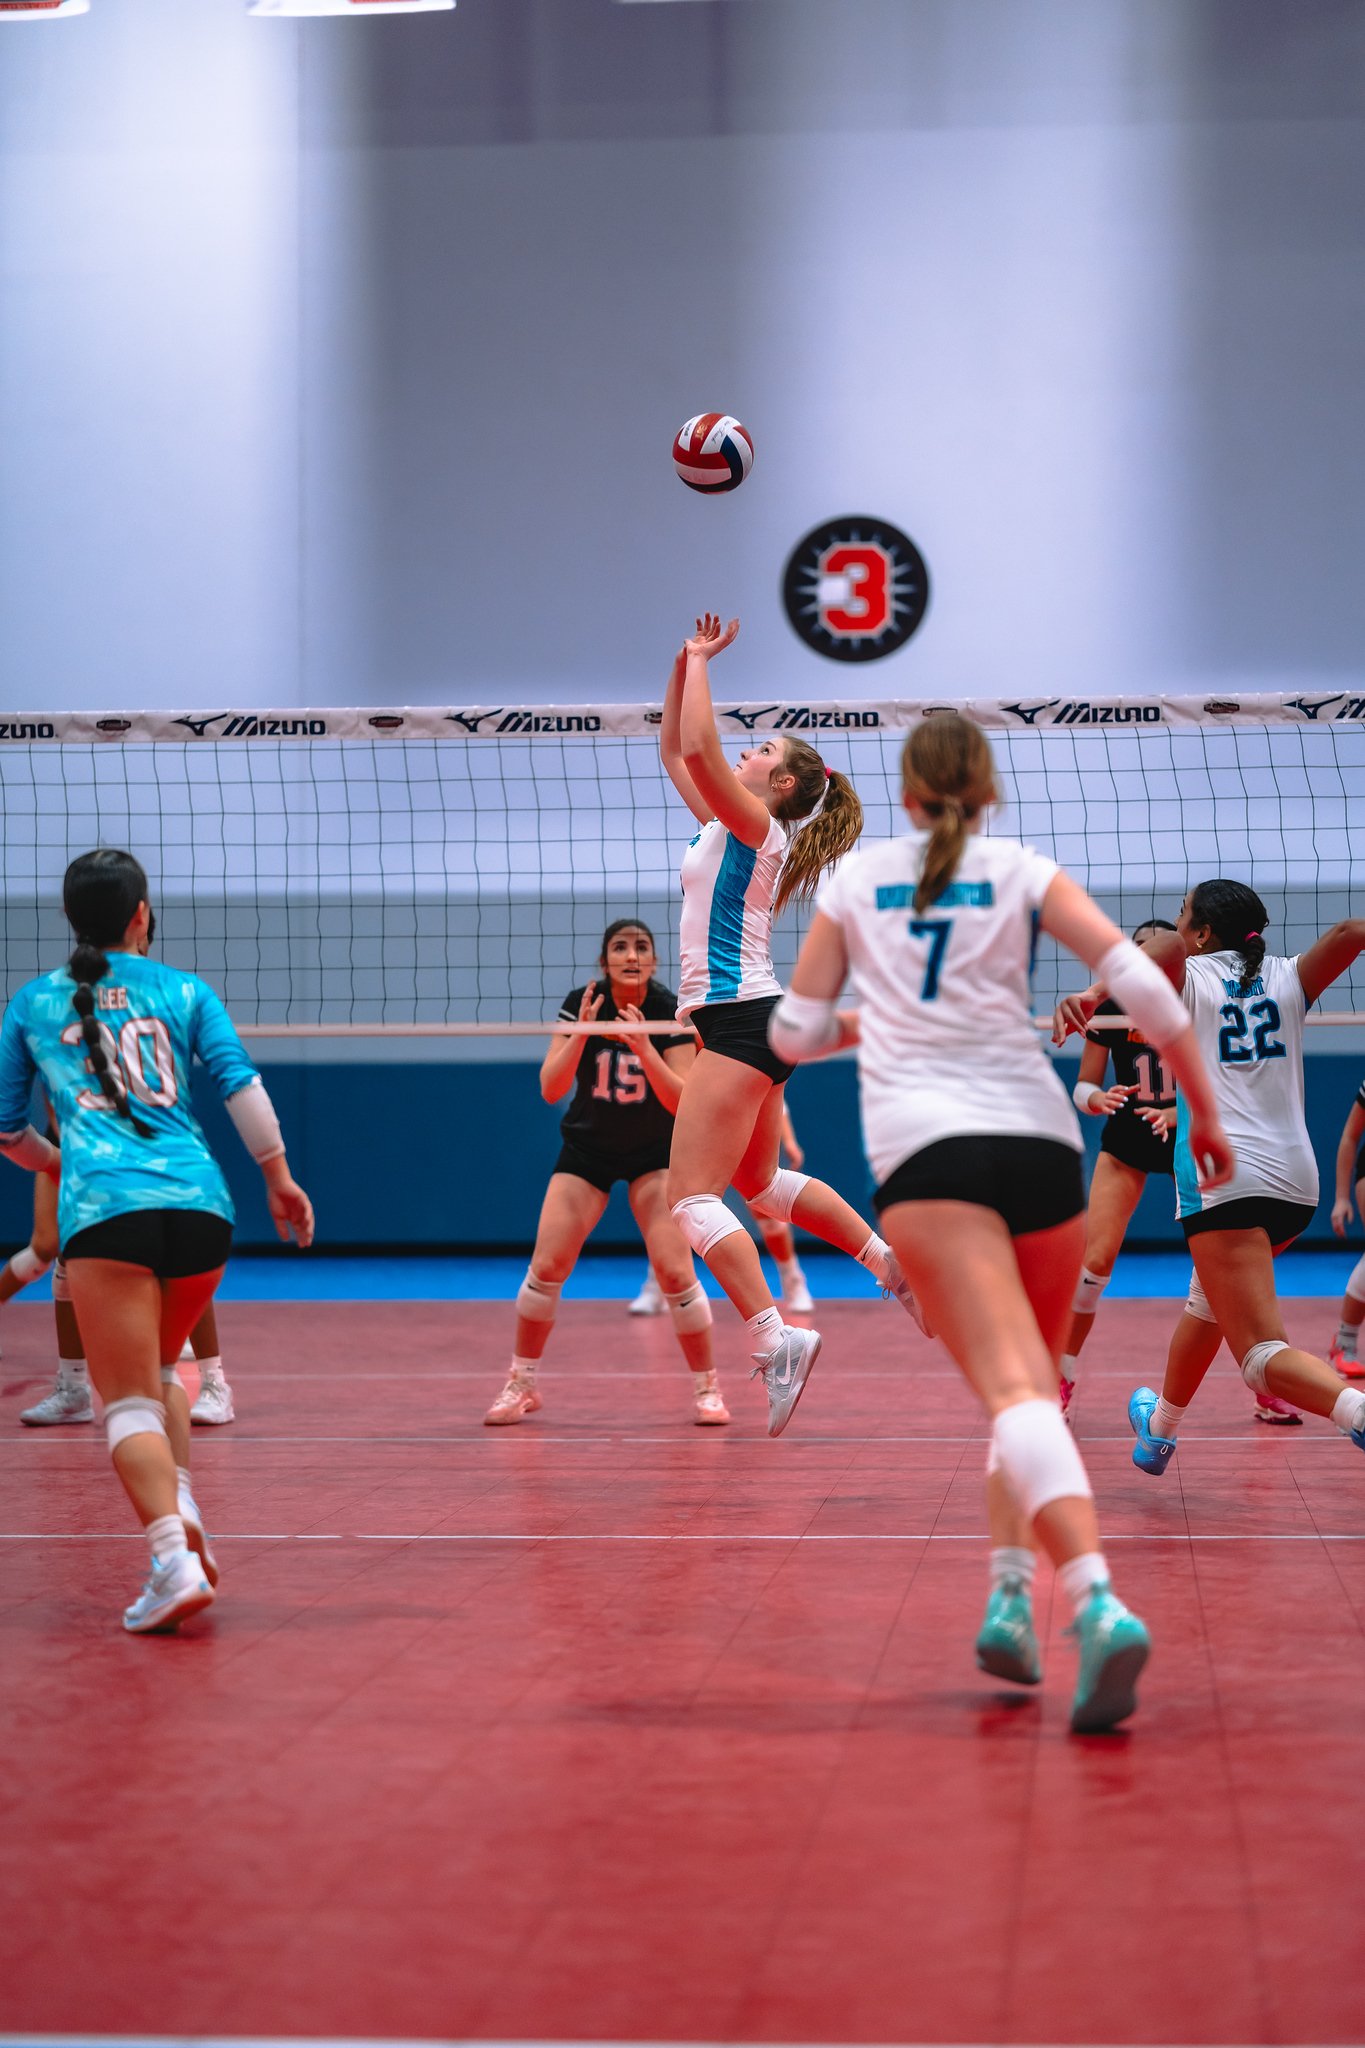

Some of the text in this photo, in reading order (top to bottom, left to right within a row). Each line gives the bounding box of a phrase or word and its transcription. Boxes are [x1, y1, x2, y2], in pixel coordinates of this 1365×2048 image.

[820, 544, 892, 636] 3
[908, 919, 954, 1002] 7
[98, 987, 128, 1010] LEE
[1219, 998, 1286, 1062] 22
[60, 1017, 178, 1110] 30
[592, 1049, 647, 1104] 15
[1133, 1053, 1176, 1101] 11
